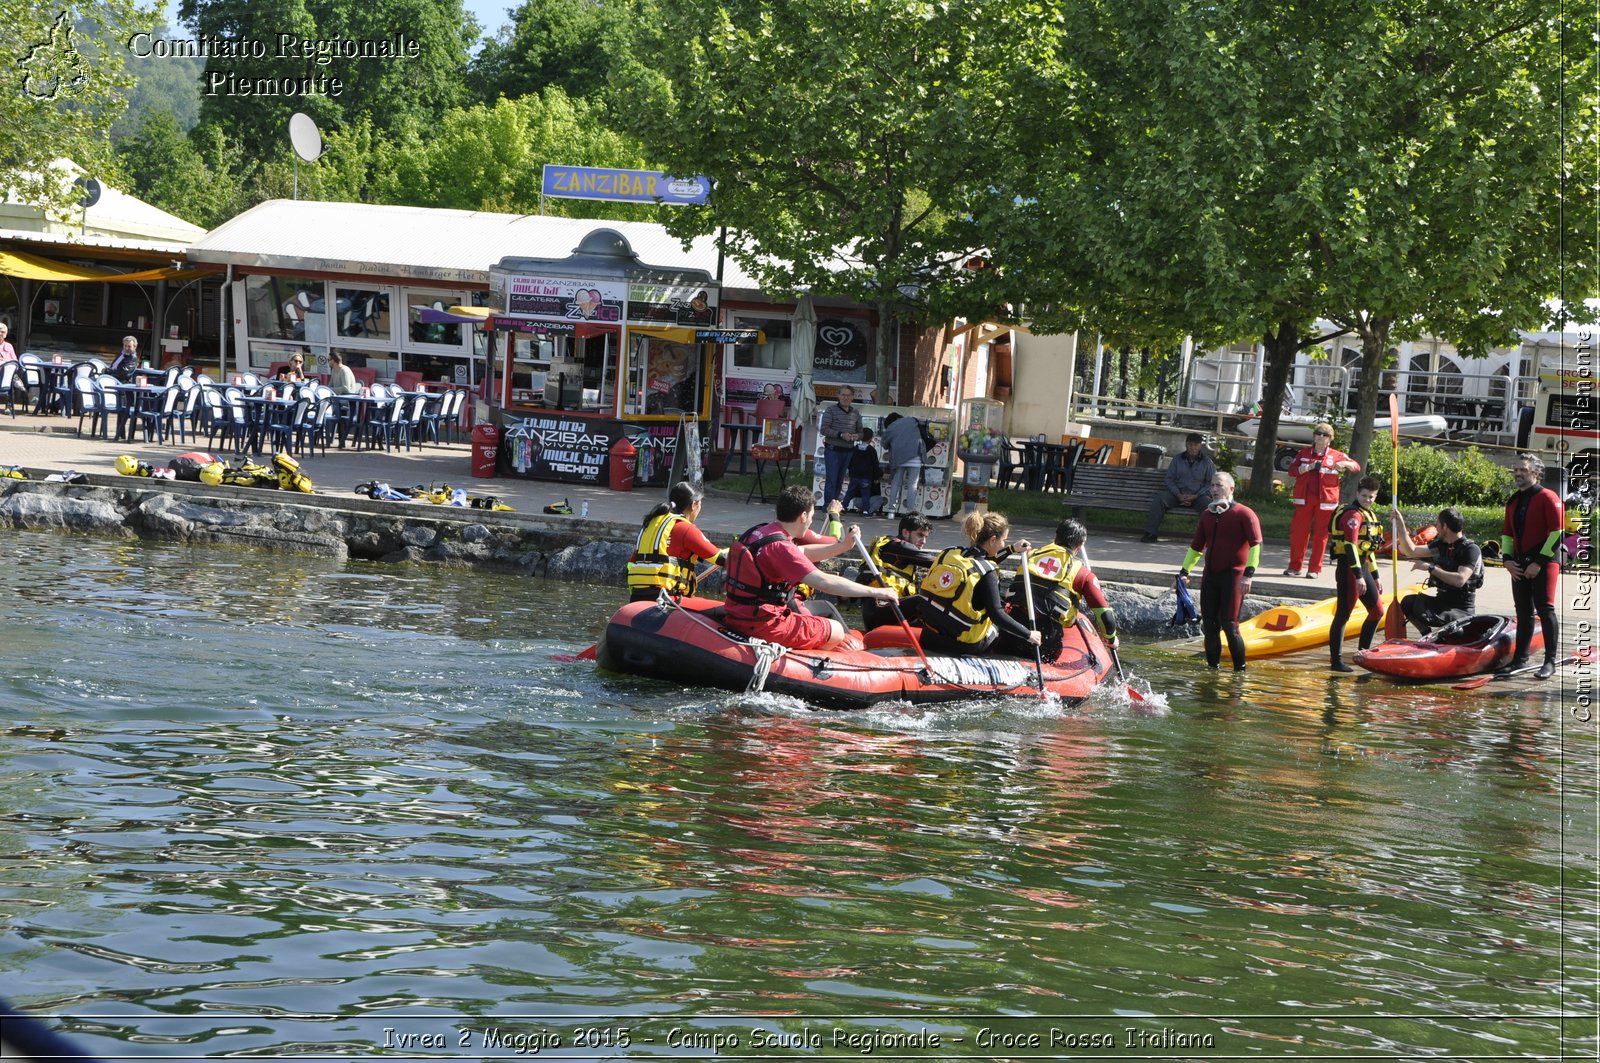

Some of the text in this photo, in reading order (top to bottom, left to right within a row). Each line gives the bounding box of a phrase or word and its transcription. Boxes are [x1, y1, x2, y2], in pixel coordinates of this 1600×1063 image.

[553, 172, 657, 196] ZANZIBAR
[545, 279, 596, 288] ZANZIBAR
[511, 295, 561, 303] GELATERIA
[526, 321, 575, 330] ZANZIBAR
[505, 424, 609, 446] ZANZIBAR
[544, 442, 609, 452] viverone
